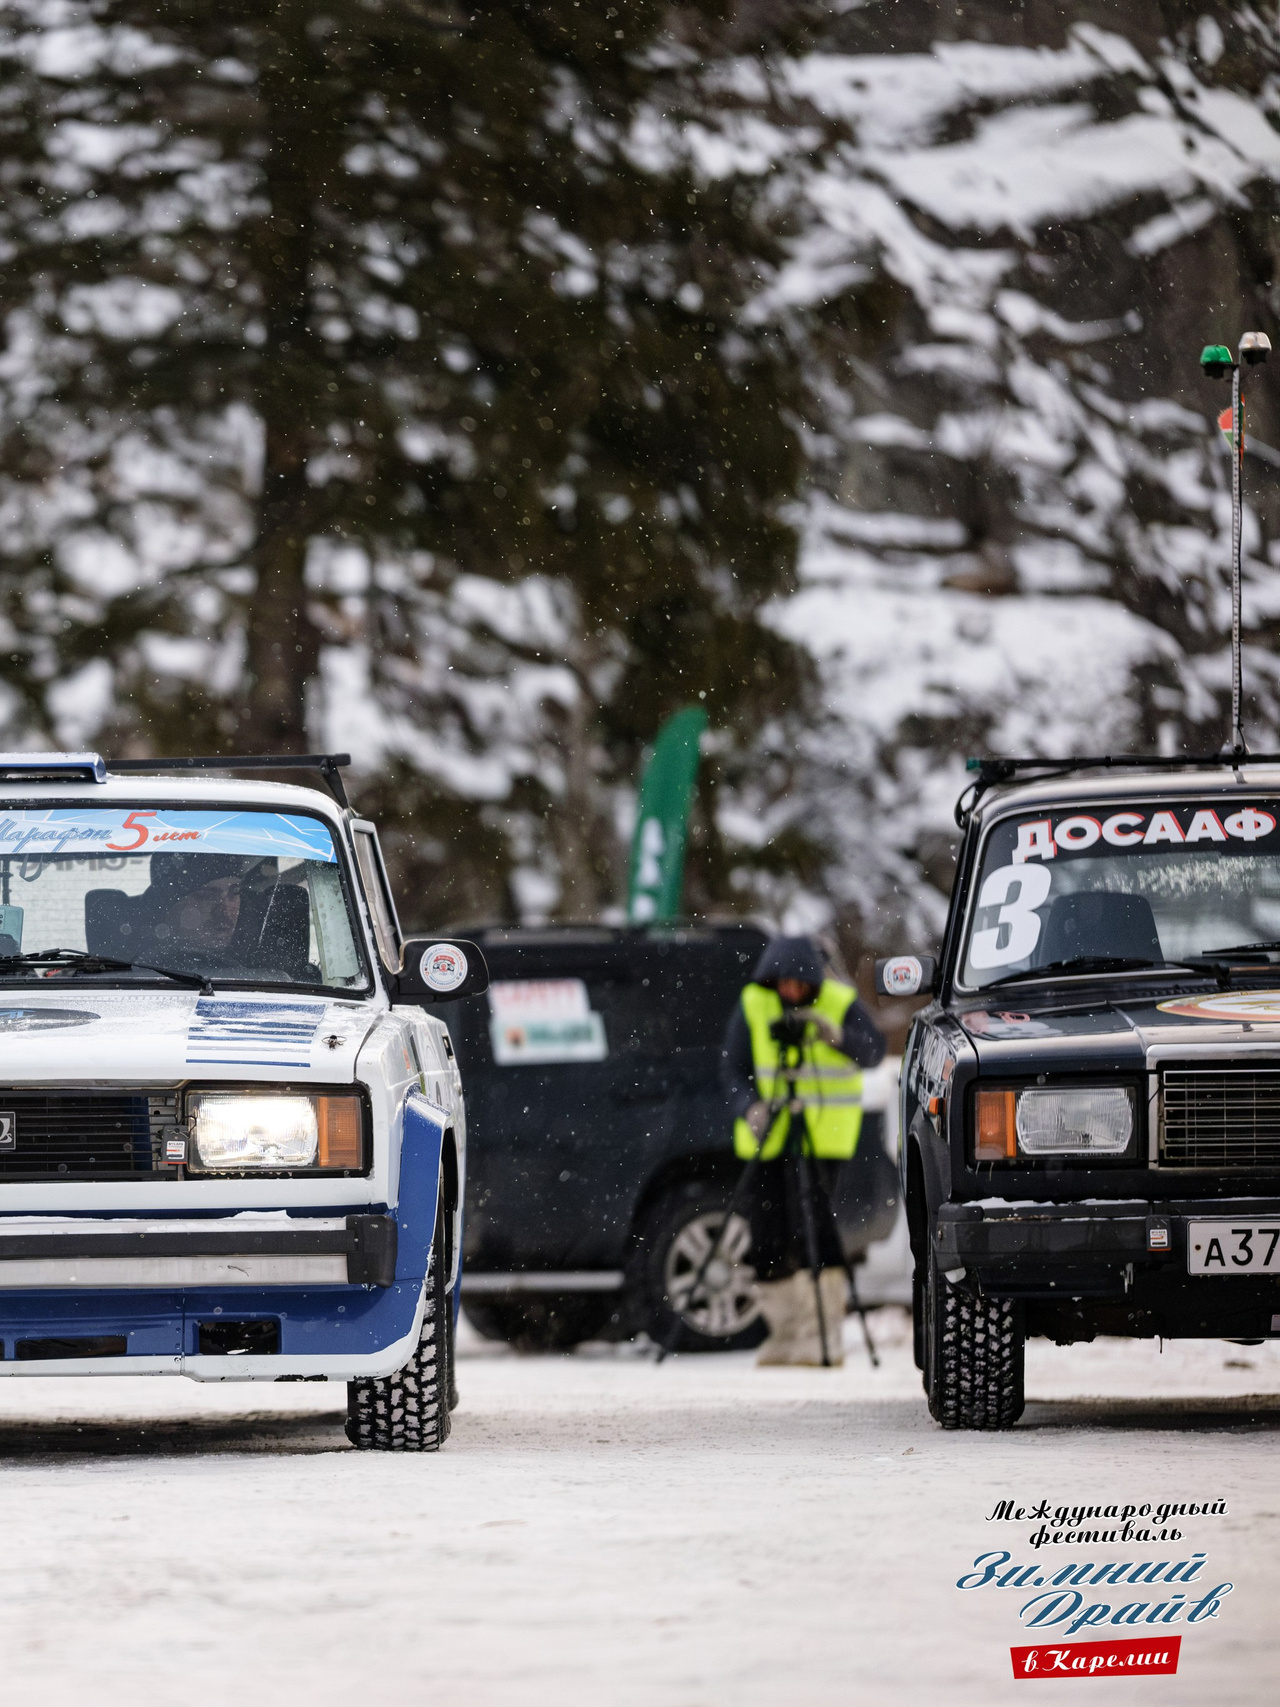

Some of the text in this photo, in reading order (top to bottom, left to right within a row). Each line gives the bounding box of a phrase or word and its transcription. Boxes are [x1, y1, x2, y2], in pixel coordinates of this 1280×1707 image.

[105, 811, 157, 851] 5
[153, 830, 203, 842] лет
[1012, 807, 1277, 866] ДОСААФ
[970, 863, 1052, 970] 3
